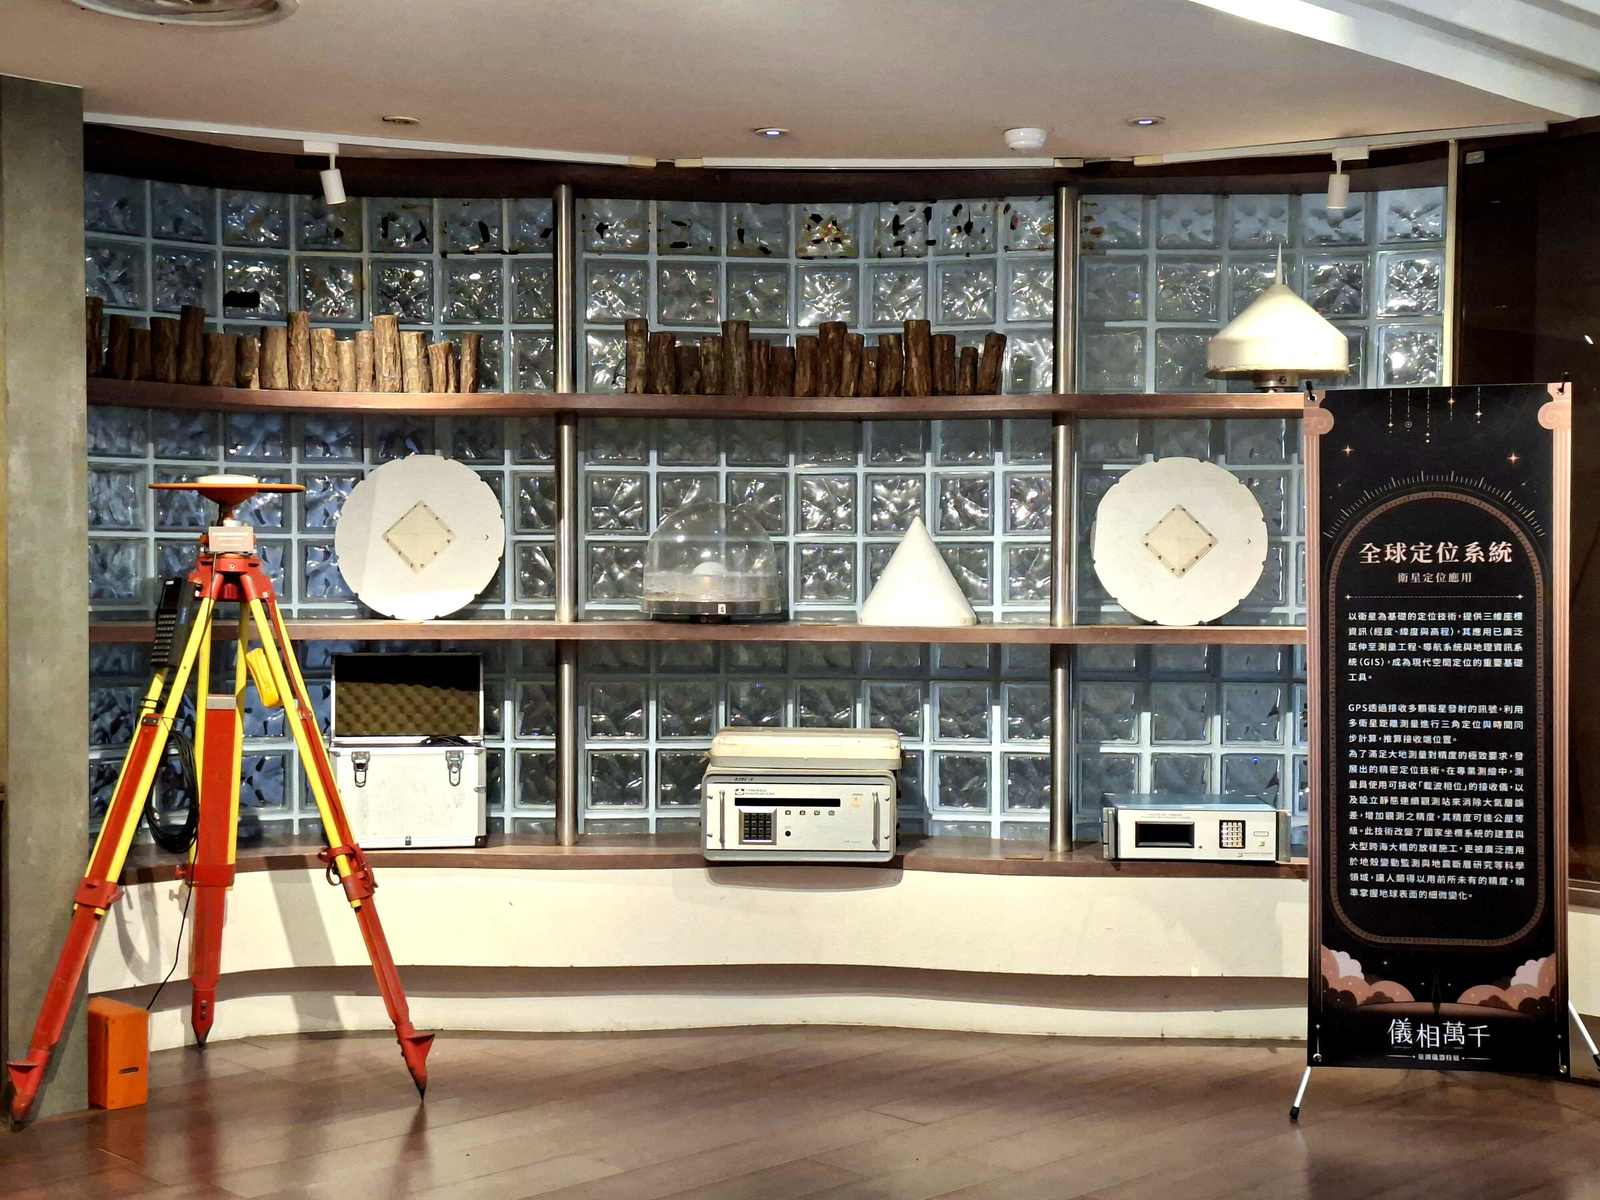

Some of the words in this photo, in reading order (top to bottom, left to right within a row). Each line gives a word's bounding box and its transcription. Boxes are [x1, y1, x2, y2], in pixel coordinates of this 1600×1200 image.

[1359, 540, 1513, 564] 全球定位系統
[1397, 572, 1472, 583] 衛星定位應用
[1386, 1017, 1491, 1049] 儀相萬千
